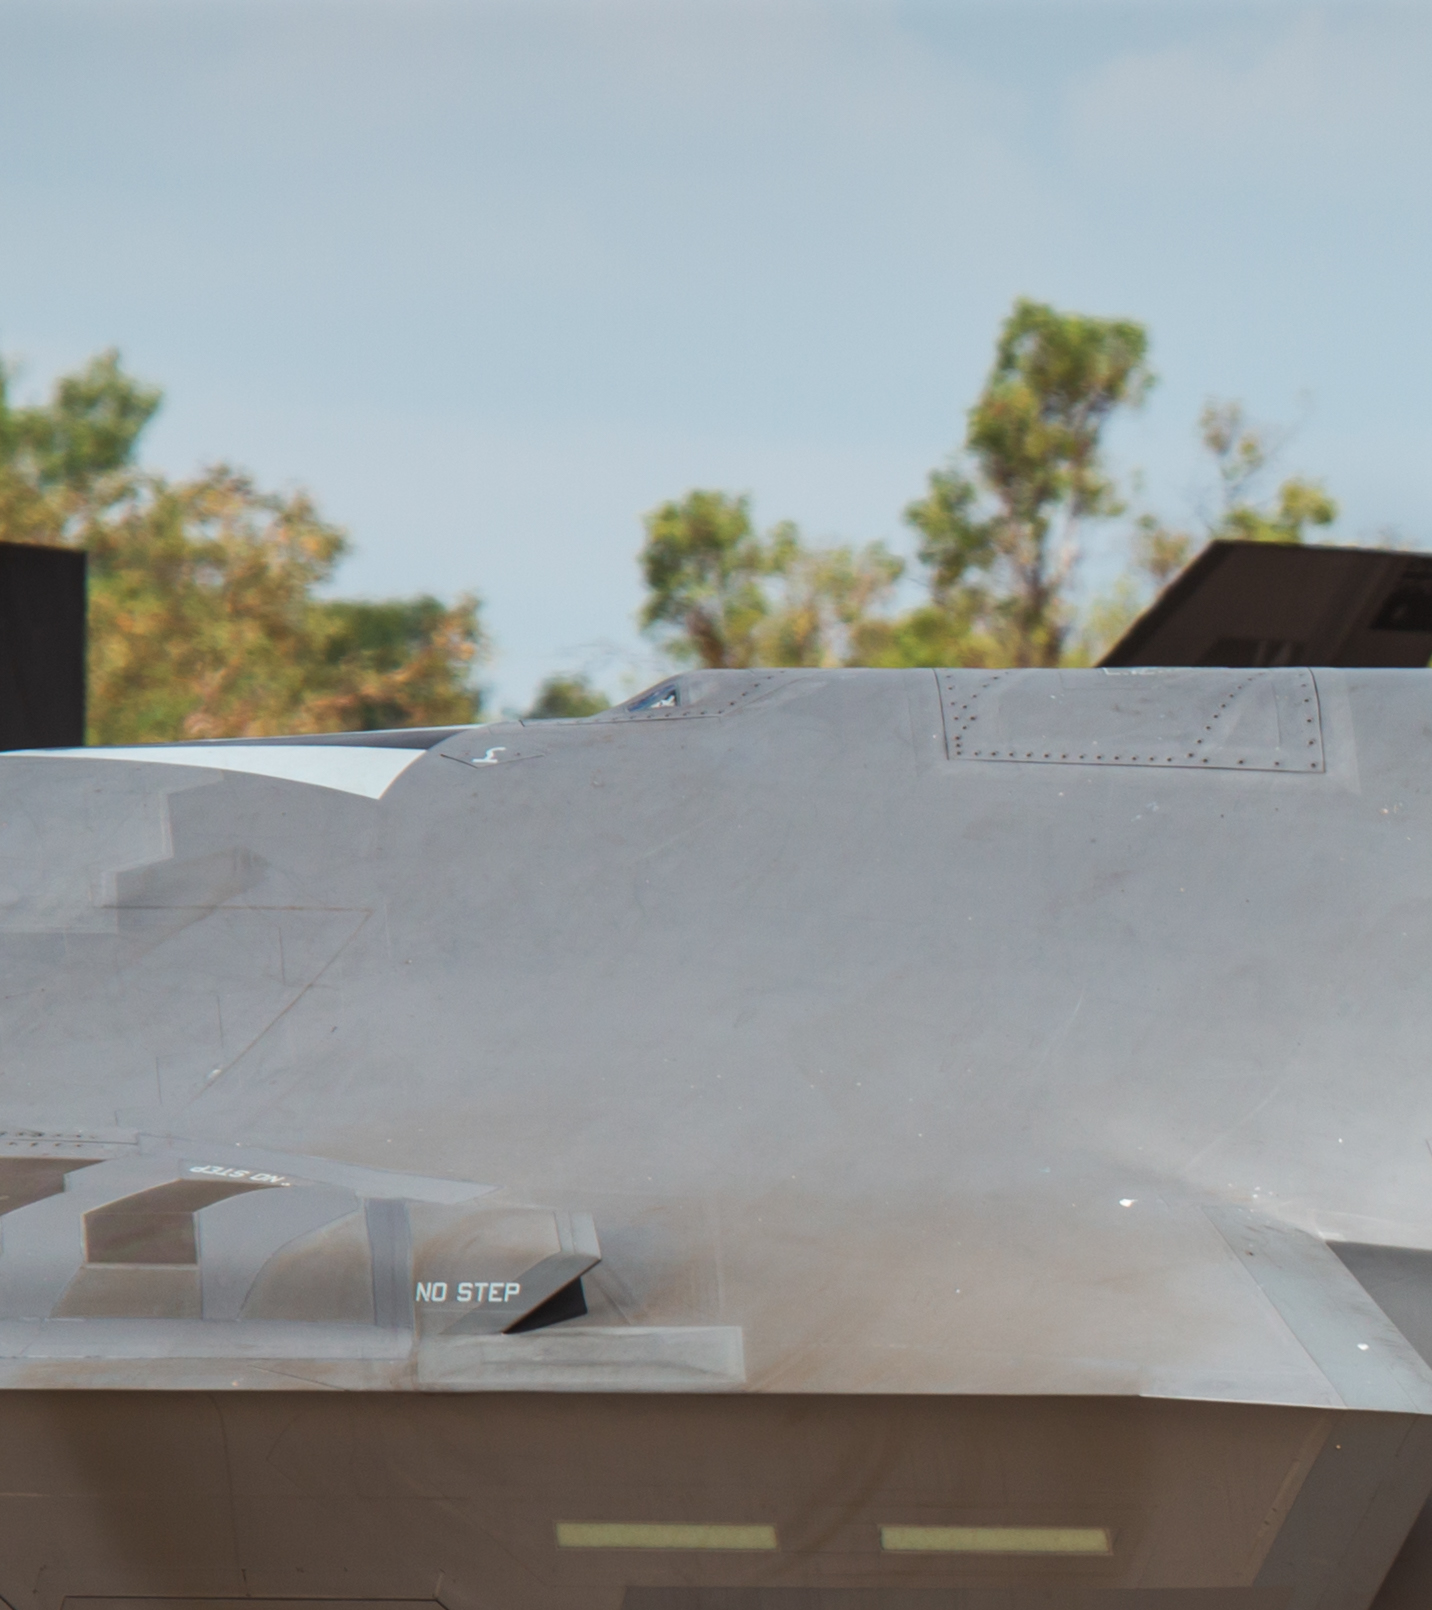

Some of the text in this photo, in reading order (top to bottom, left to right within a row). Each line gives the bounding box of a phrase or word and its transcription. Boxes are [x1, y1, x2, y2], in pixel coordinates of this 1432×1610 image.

[189, 1165, 285, 1183] NO STEP
[416, 1281, 521, 1303] NO STEP
